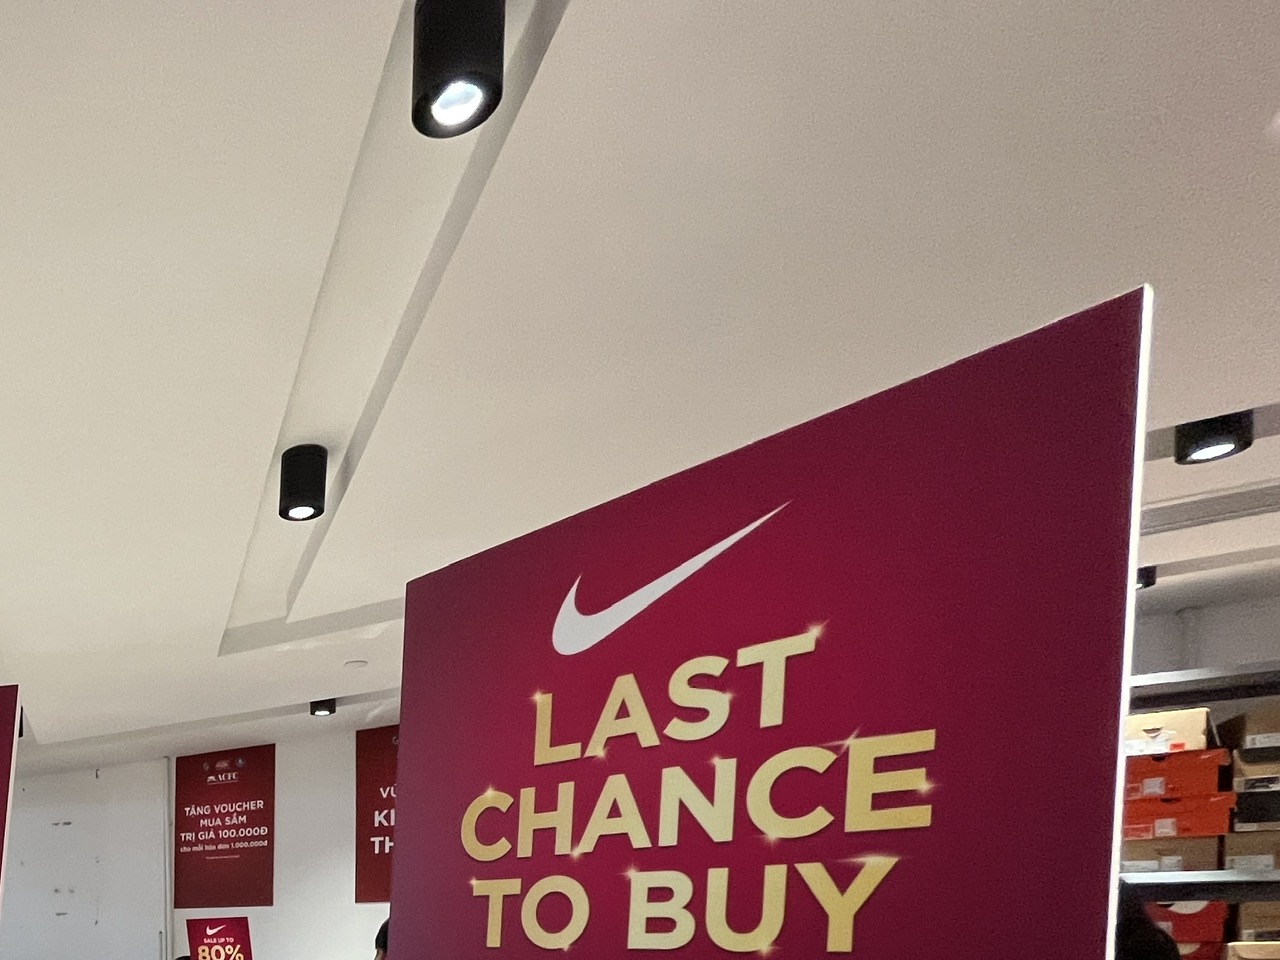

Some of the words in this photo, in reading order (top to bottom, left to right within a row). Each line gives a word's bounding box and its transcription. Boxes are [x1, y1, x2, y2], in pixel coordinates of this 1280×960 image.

[532, 624, 822, 767] LAST
[200, 818, 222, 828] MUA
[214, 800, 264, 814] VOUCHER
[460, 729, 937, 862] CHANCE
[471, 876, 591, 951] TO
[627, 856, 900, 955] BUY
